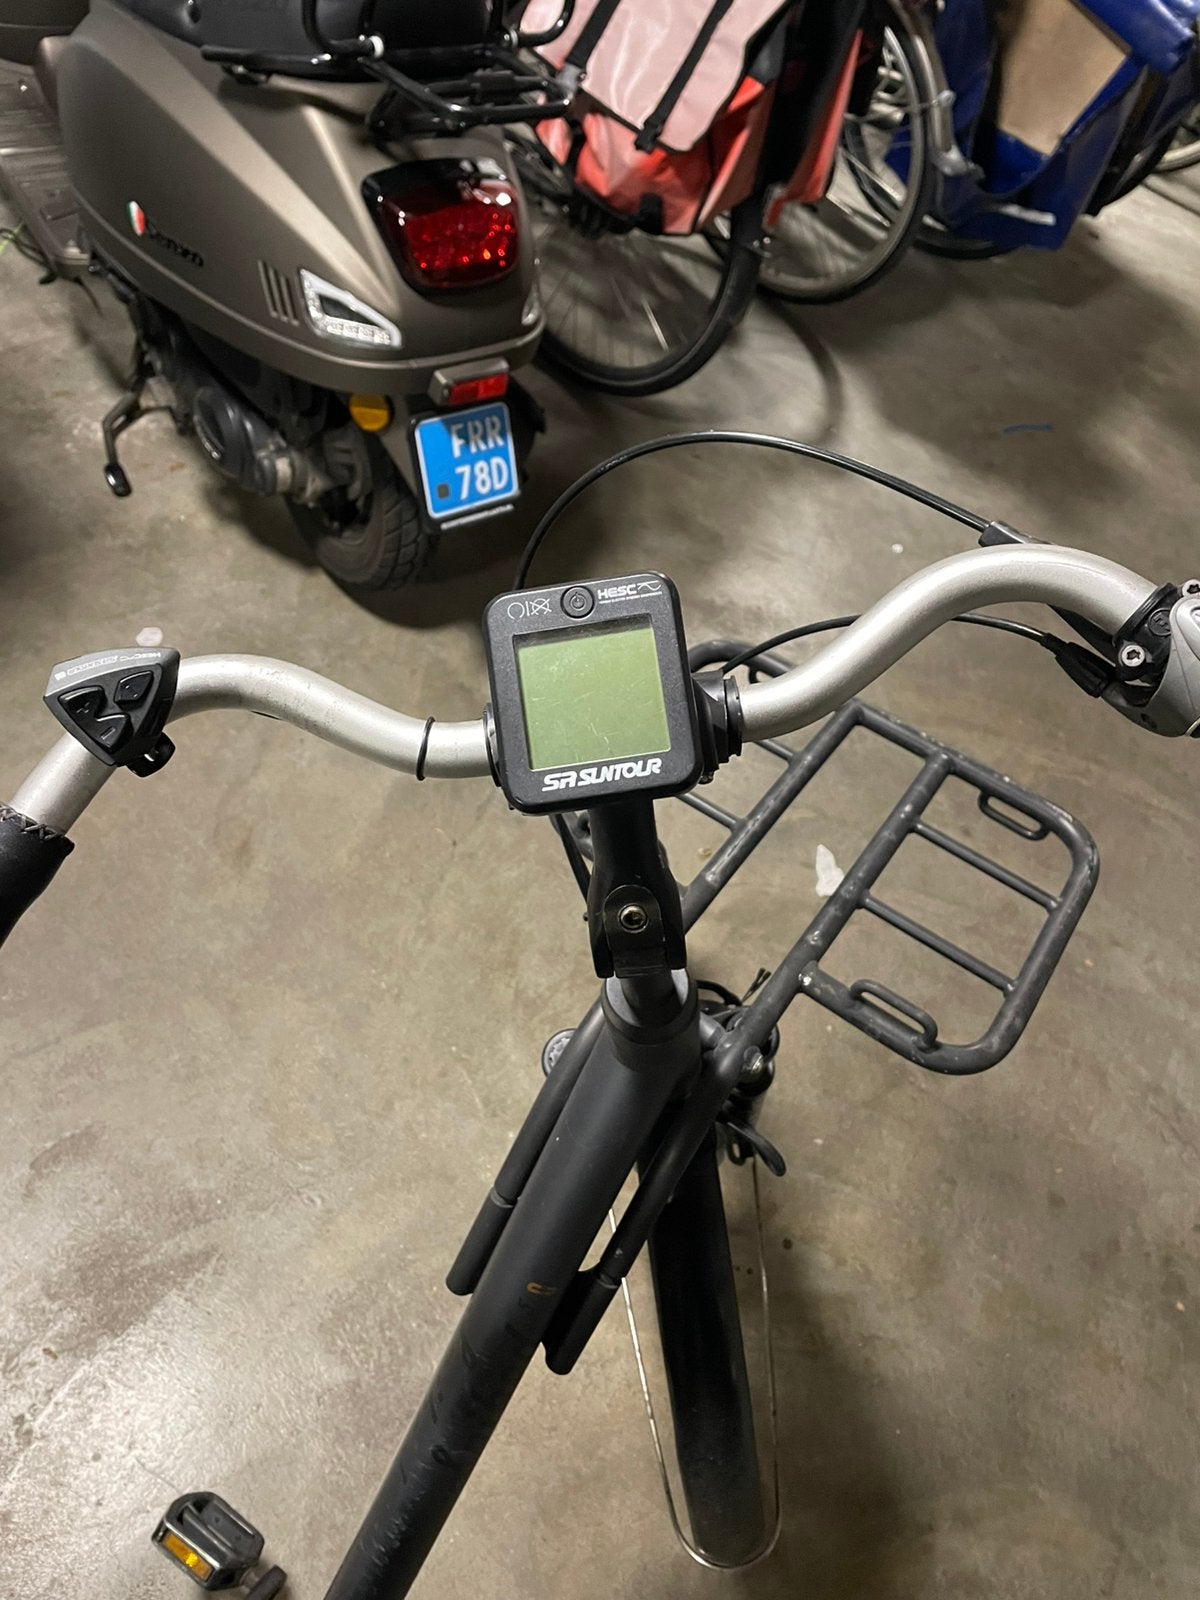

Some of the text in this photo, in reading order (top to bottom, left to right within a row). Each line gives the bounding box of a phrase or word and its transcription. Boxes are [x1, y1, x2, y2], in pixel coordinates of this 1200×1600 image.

[451, 416, 505, 458] FRR
[455, 456, 509, 500] 78D
[597, 583, 637, 599] HESC
[541, 757, 662, 792] SR SUNTOUR
